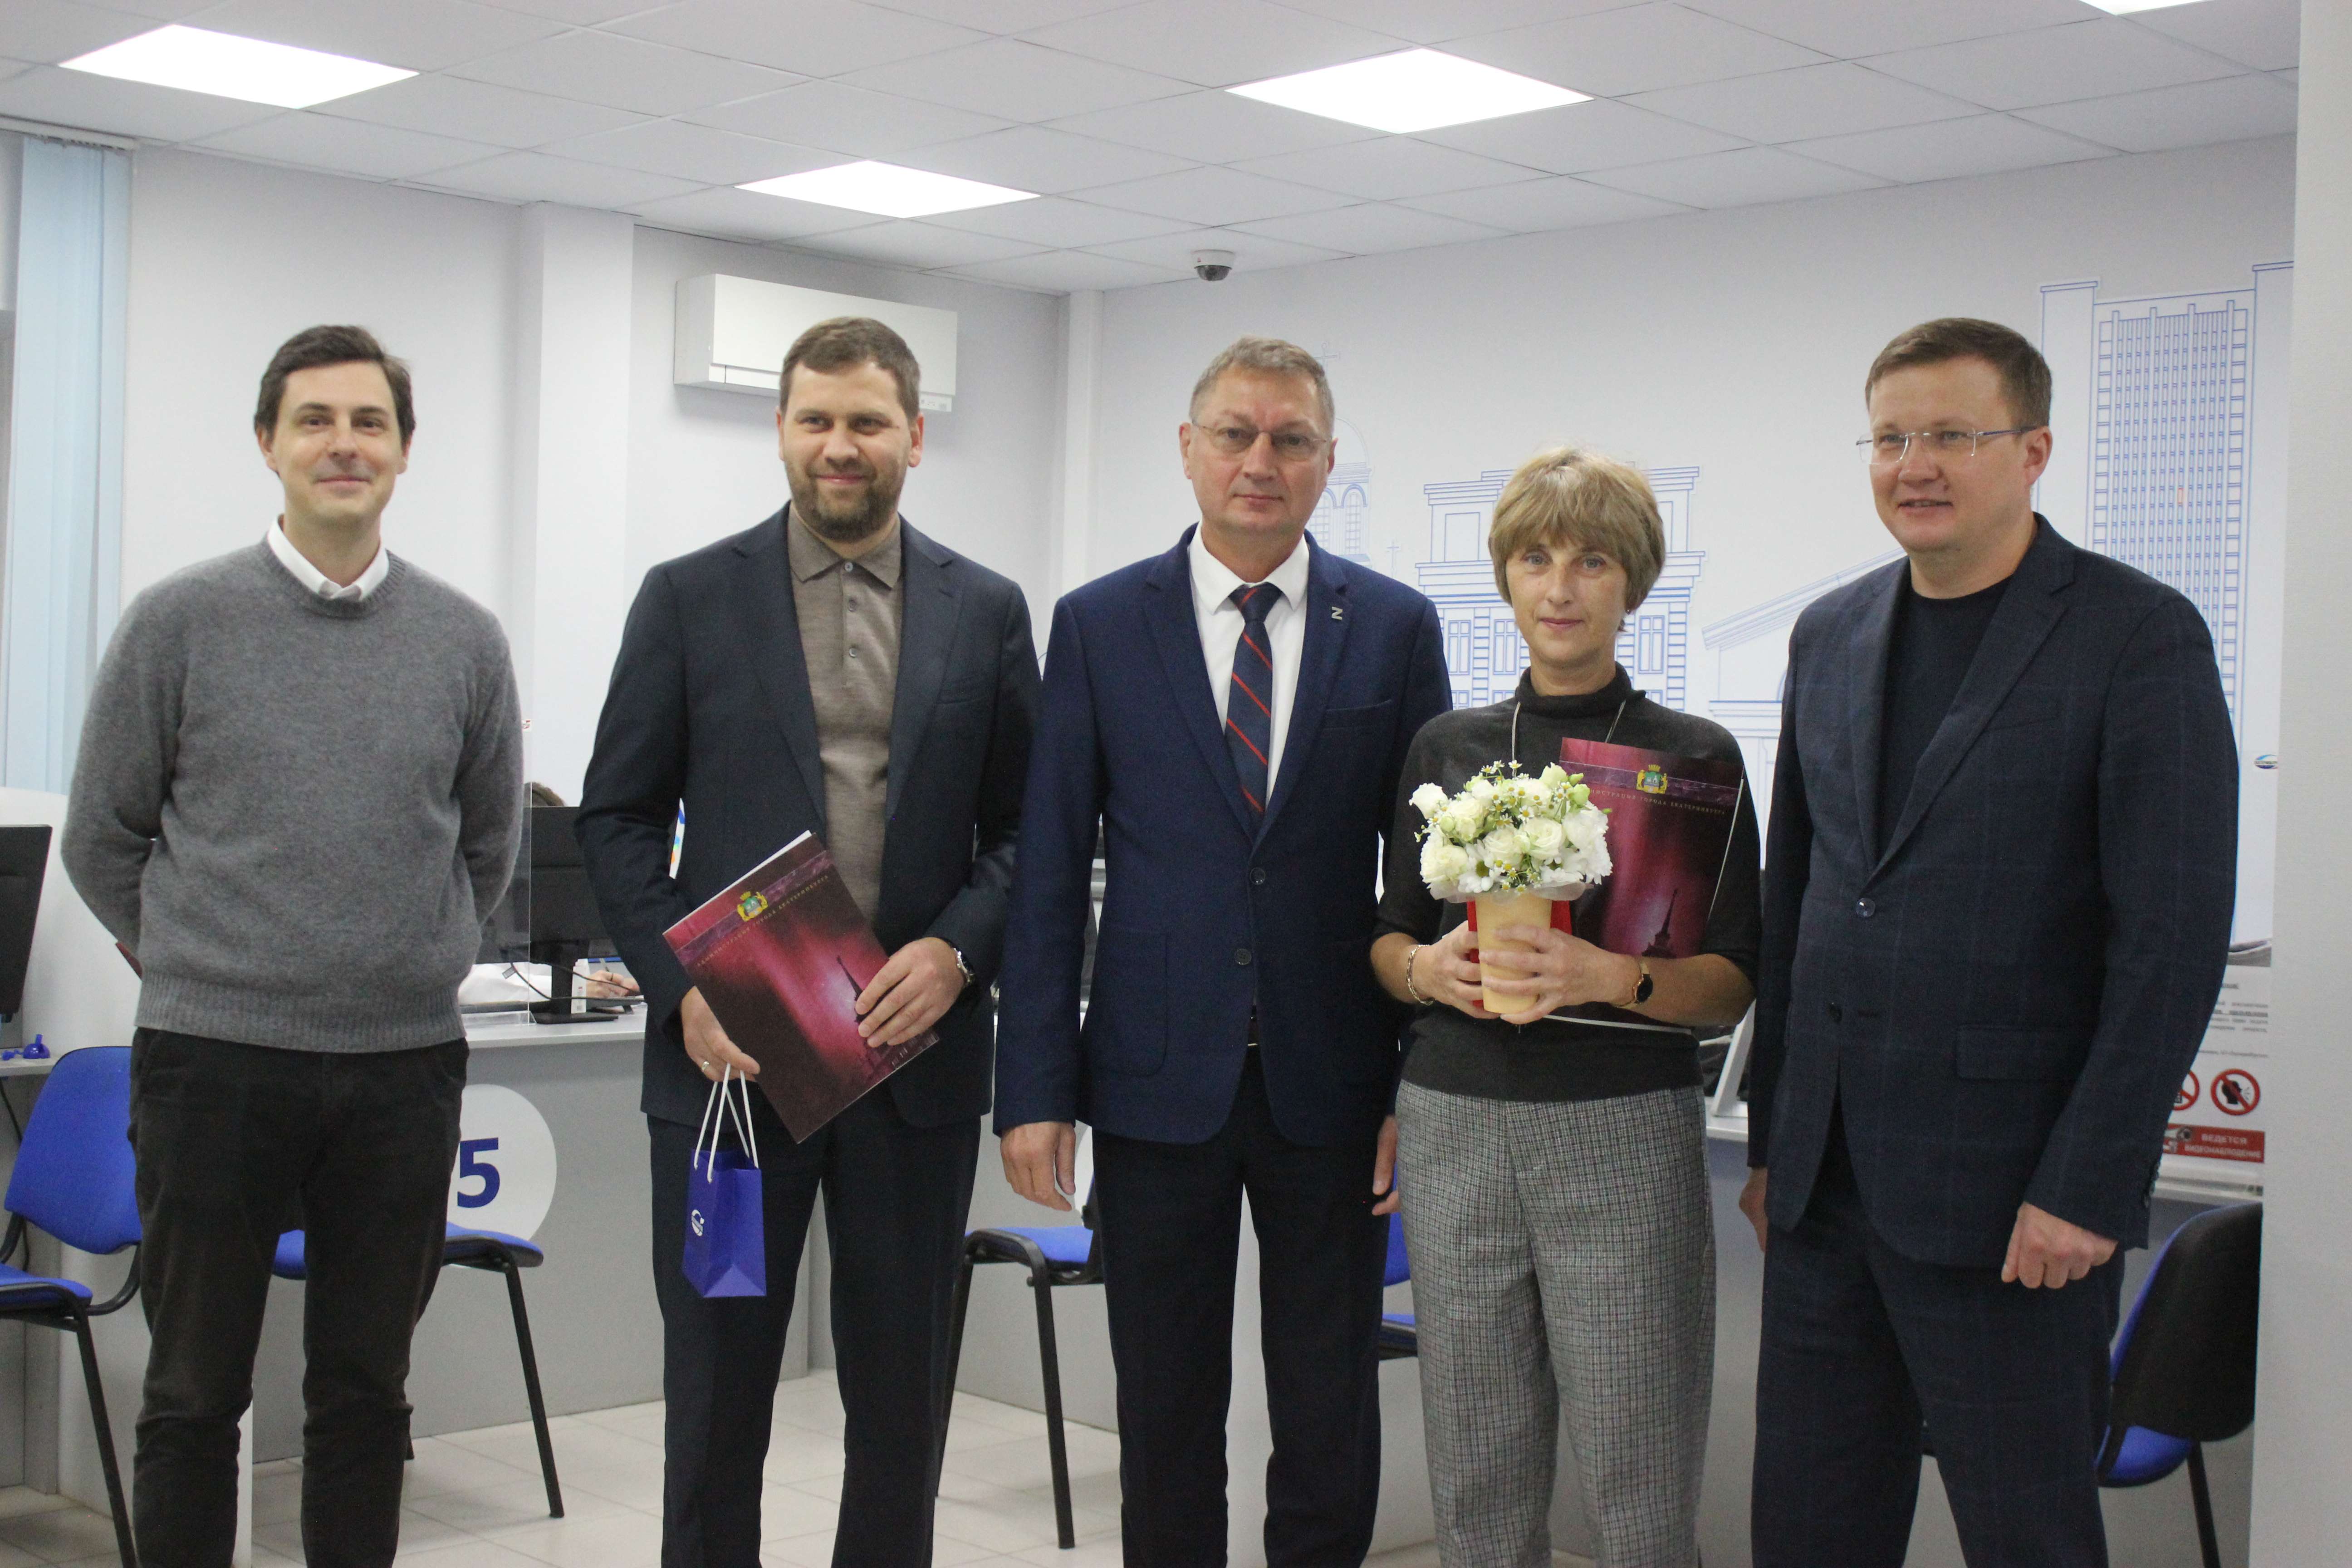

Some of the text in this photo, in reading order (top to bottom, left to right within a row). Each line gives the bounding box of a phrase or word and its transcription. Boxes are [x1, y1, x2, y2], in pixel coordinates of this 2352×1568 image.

[1331, 606, 1343, 620] Z
[2201, 1133, 2247, 1145] ВЕДЕТСЯ
[457, 1137, 500, 1208] 5
